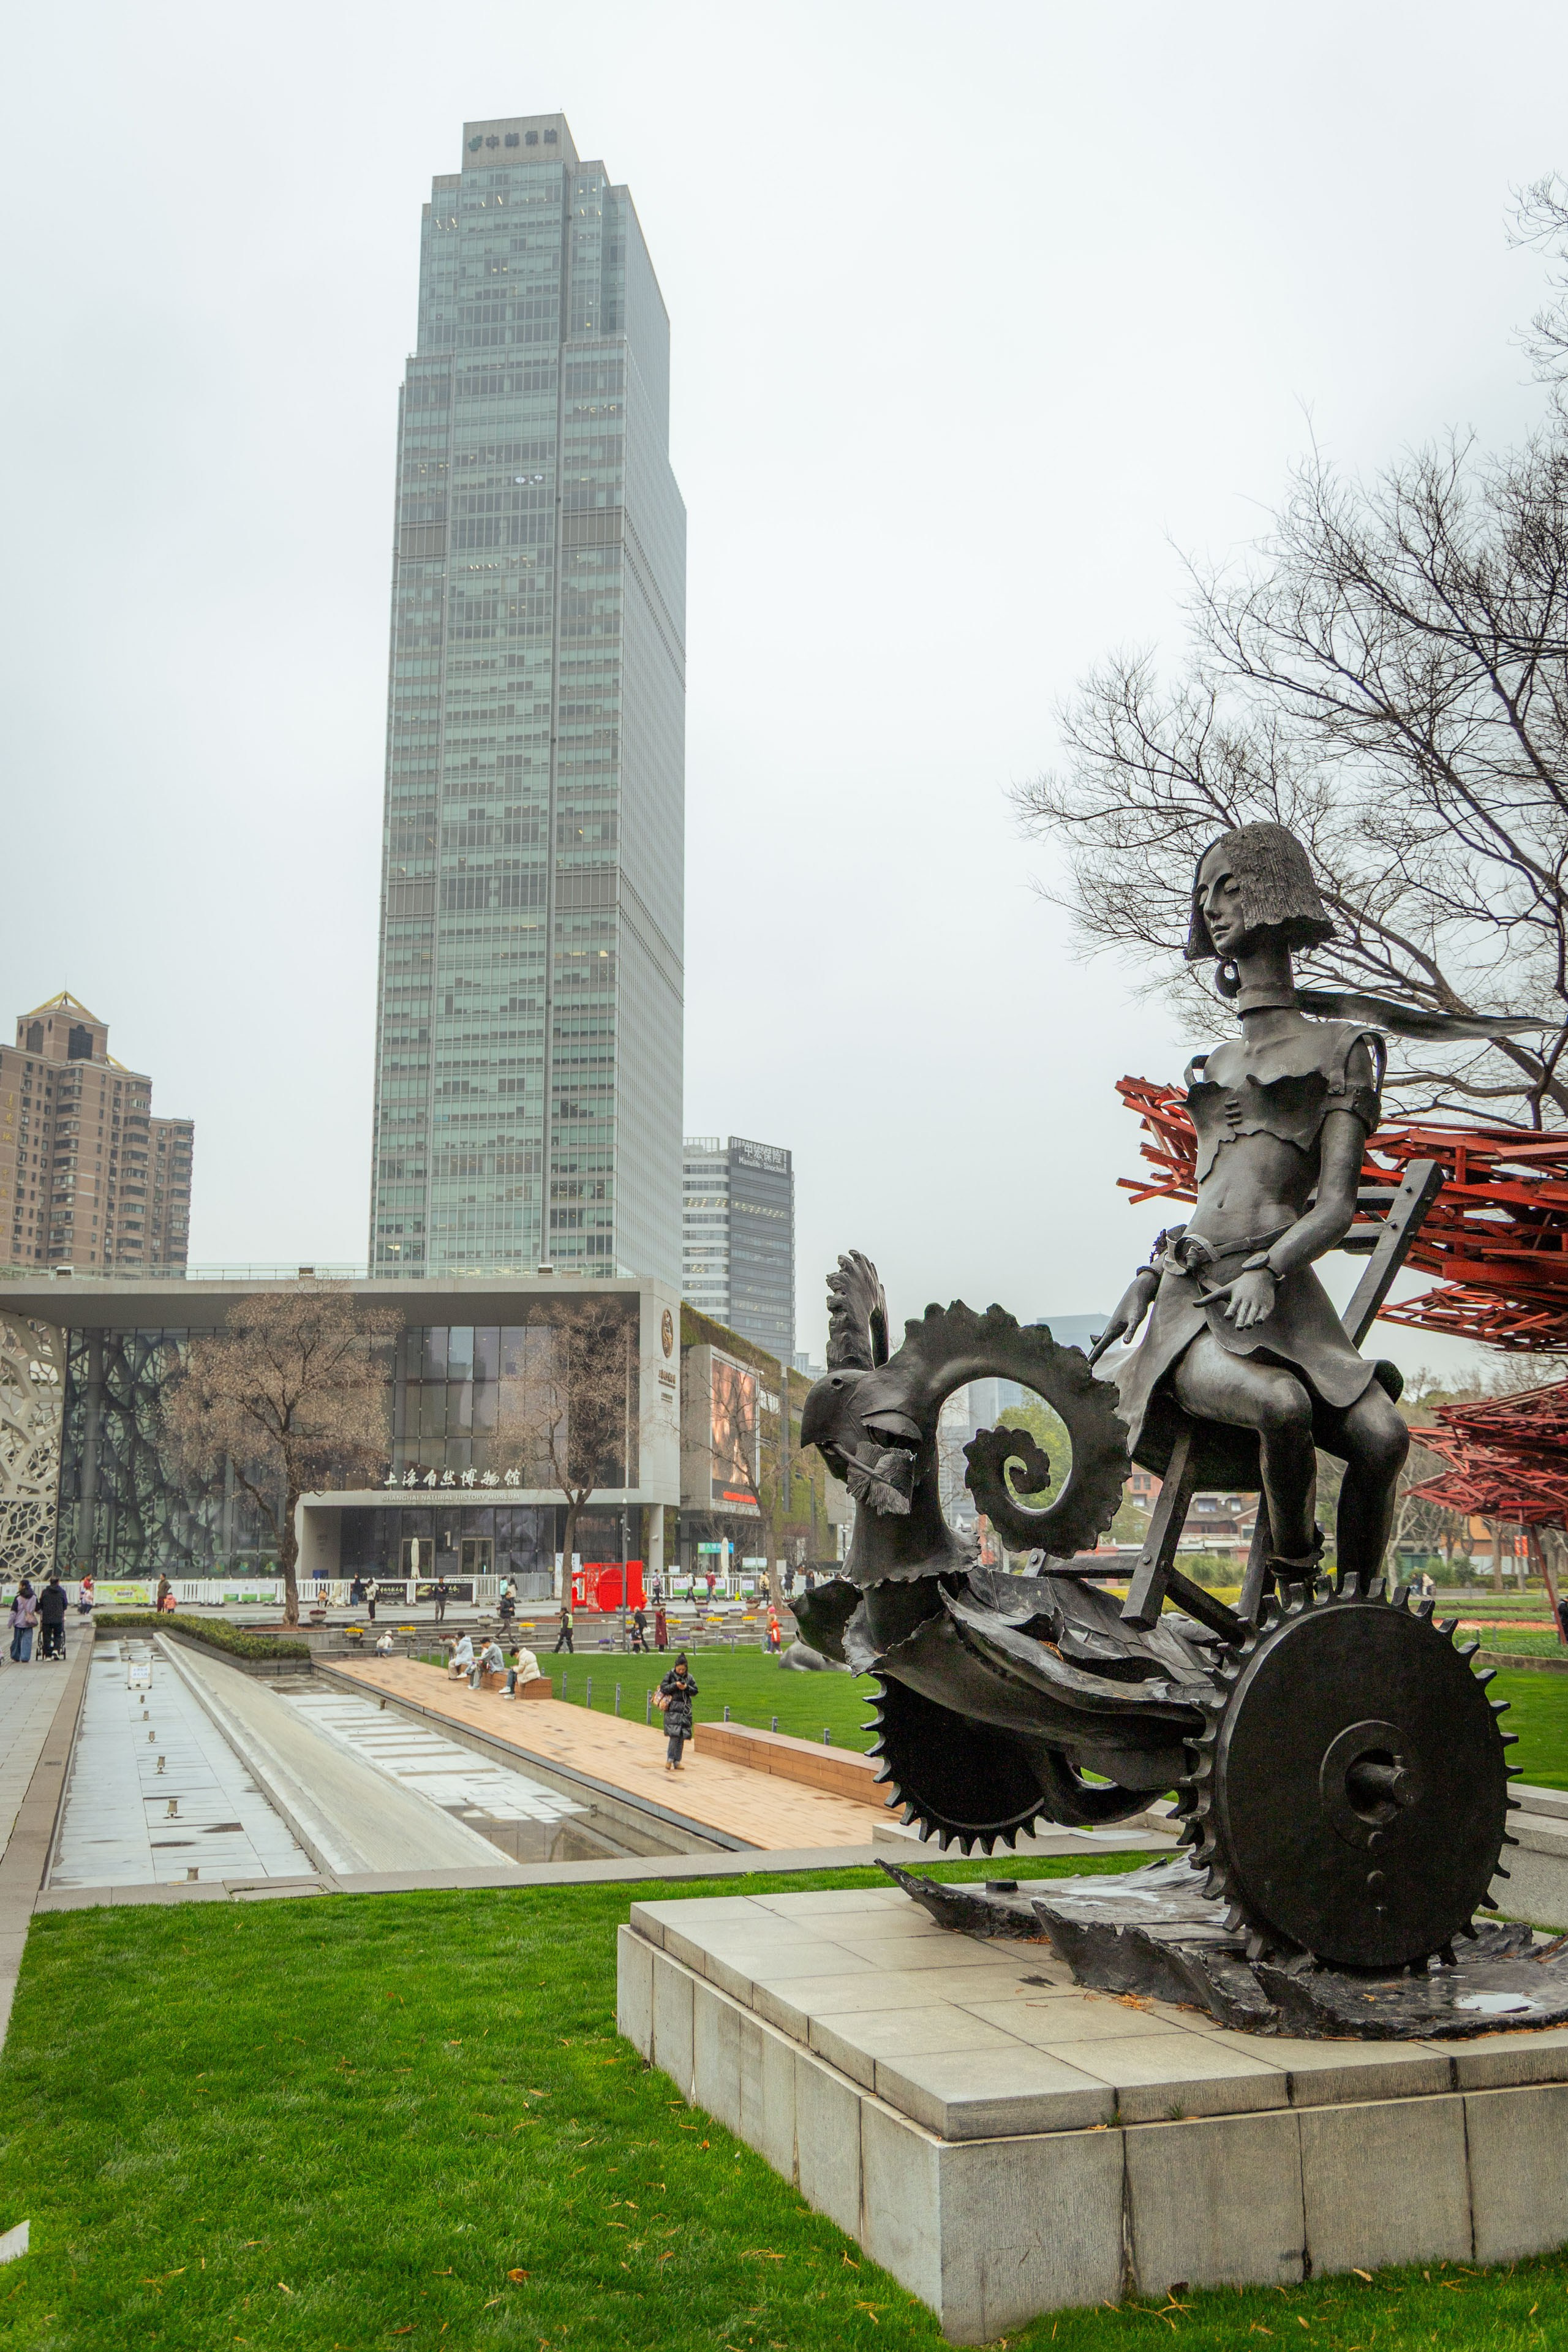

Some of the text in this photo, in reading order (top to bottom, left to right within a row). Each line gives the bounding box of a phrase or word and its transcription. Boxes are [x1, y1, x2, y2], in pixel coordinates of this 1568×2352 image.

[744, 1145, 782, 1164] 中宏保险
[444, 1531, 451, 1547] 1
